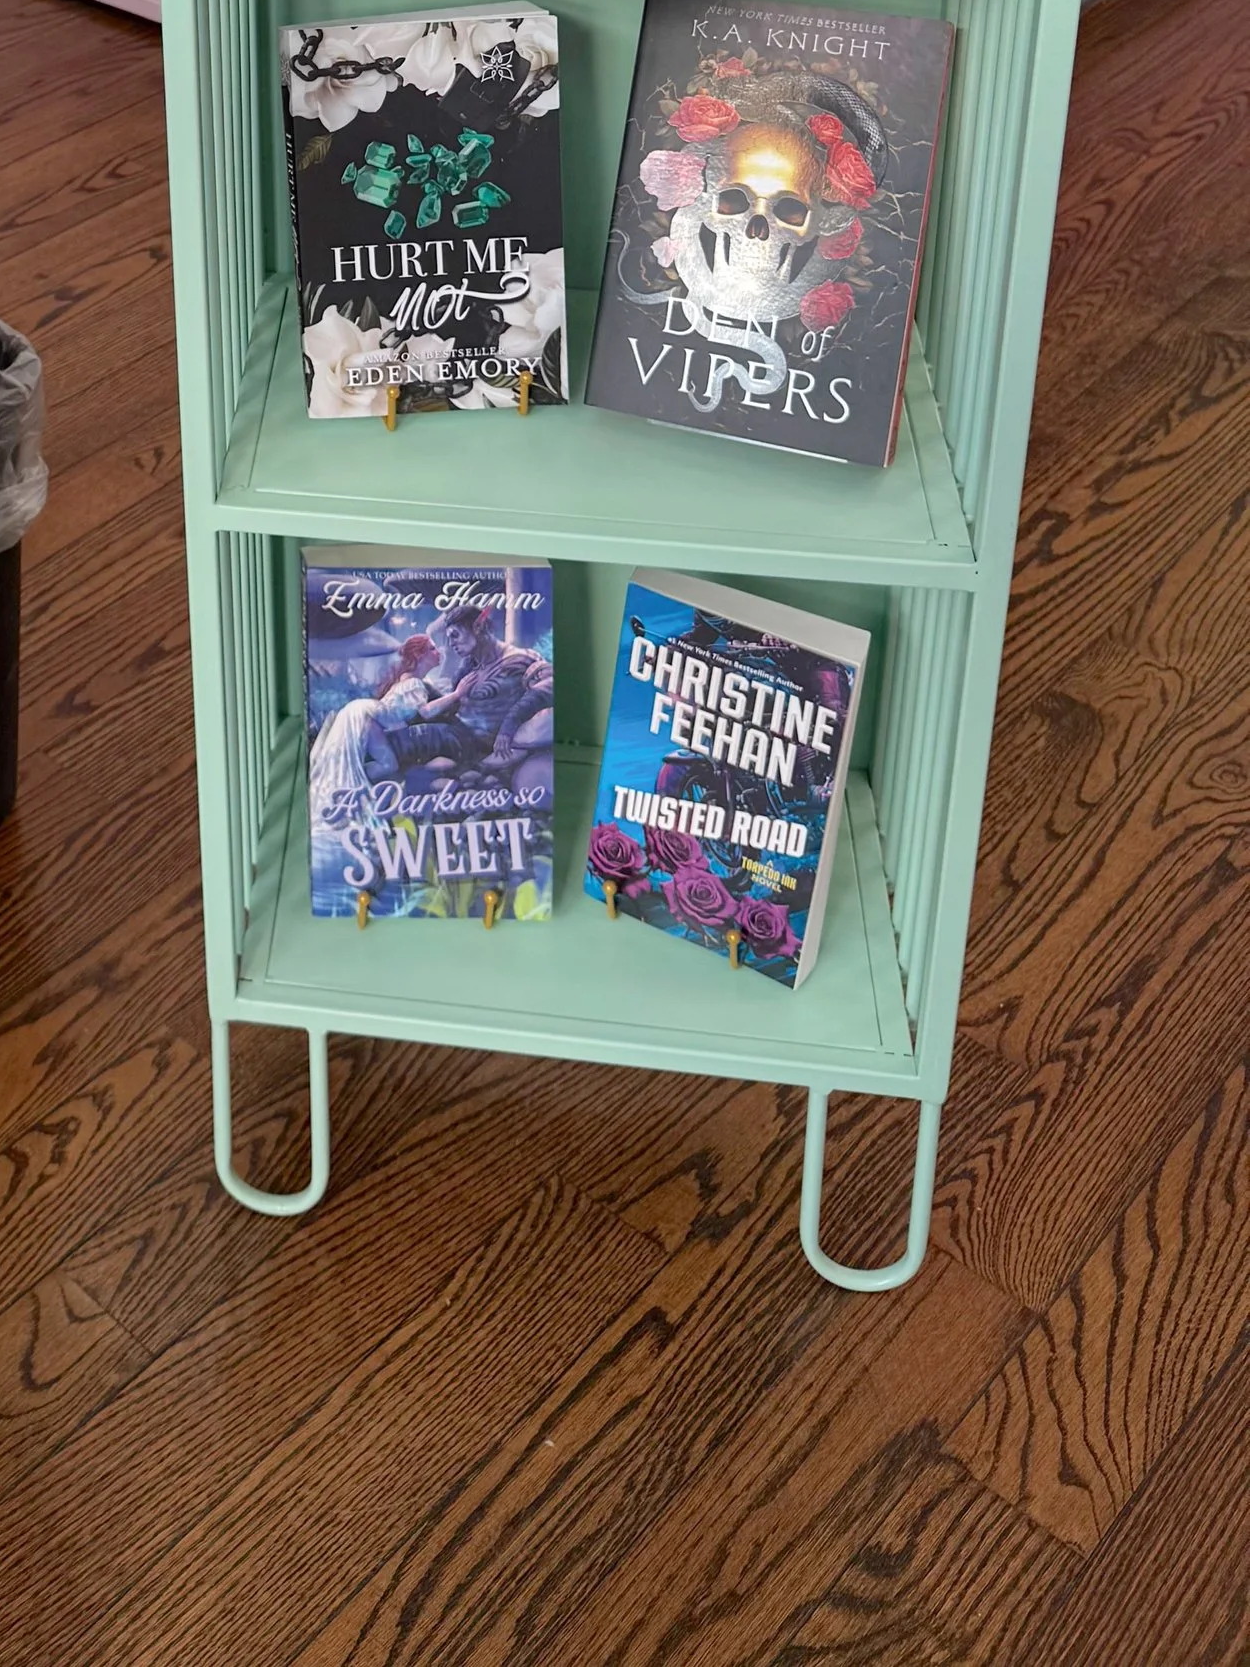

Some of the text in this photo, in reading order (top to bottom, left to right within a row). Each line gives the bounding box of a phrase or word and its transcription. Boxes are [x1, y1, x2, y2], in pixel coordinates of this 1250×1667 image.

[691, 19, 891, 61] K.A. KNIGHT
[707, 5, 886, 35] NEW YORK TIMES BESTSELLER
[331, 236, 530, 283] HURT ME
[662, 296, 831, 359] DEN of
[346, 356, 542, 387] EDEN EMORY
[365, 346, 508, 364] AMAZON BESTSELLER
[628, 336, 852, 425] VIPERS
[408, 571, 470, 581] BESTSELLING
[472, 571, 507, 580] AUTHO
[322, 580, 545, 619] Emma Hamm
[678, 640, 694, 651] New
[695, 646, 711, 658] York
[712, 653, 733, 666] Times
[734, 661, 775, 683] Bestselling
[776, 677, 804, 692] Author
[628, 635, 838, 756] CHRISTINE
[649, 691, 798, 787] FEEHAN
[322, 780, 546, 821] A Darkness so
[613, 785, 809, 858] TWISTED ROAD
[340, 817, 533, 888] SWEET
[742, 856, 781, 882] TORPEDO
[751, 873, 782, 893] NOVEL
